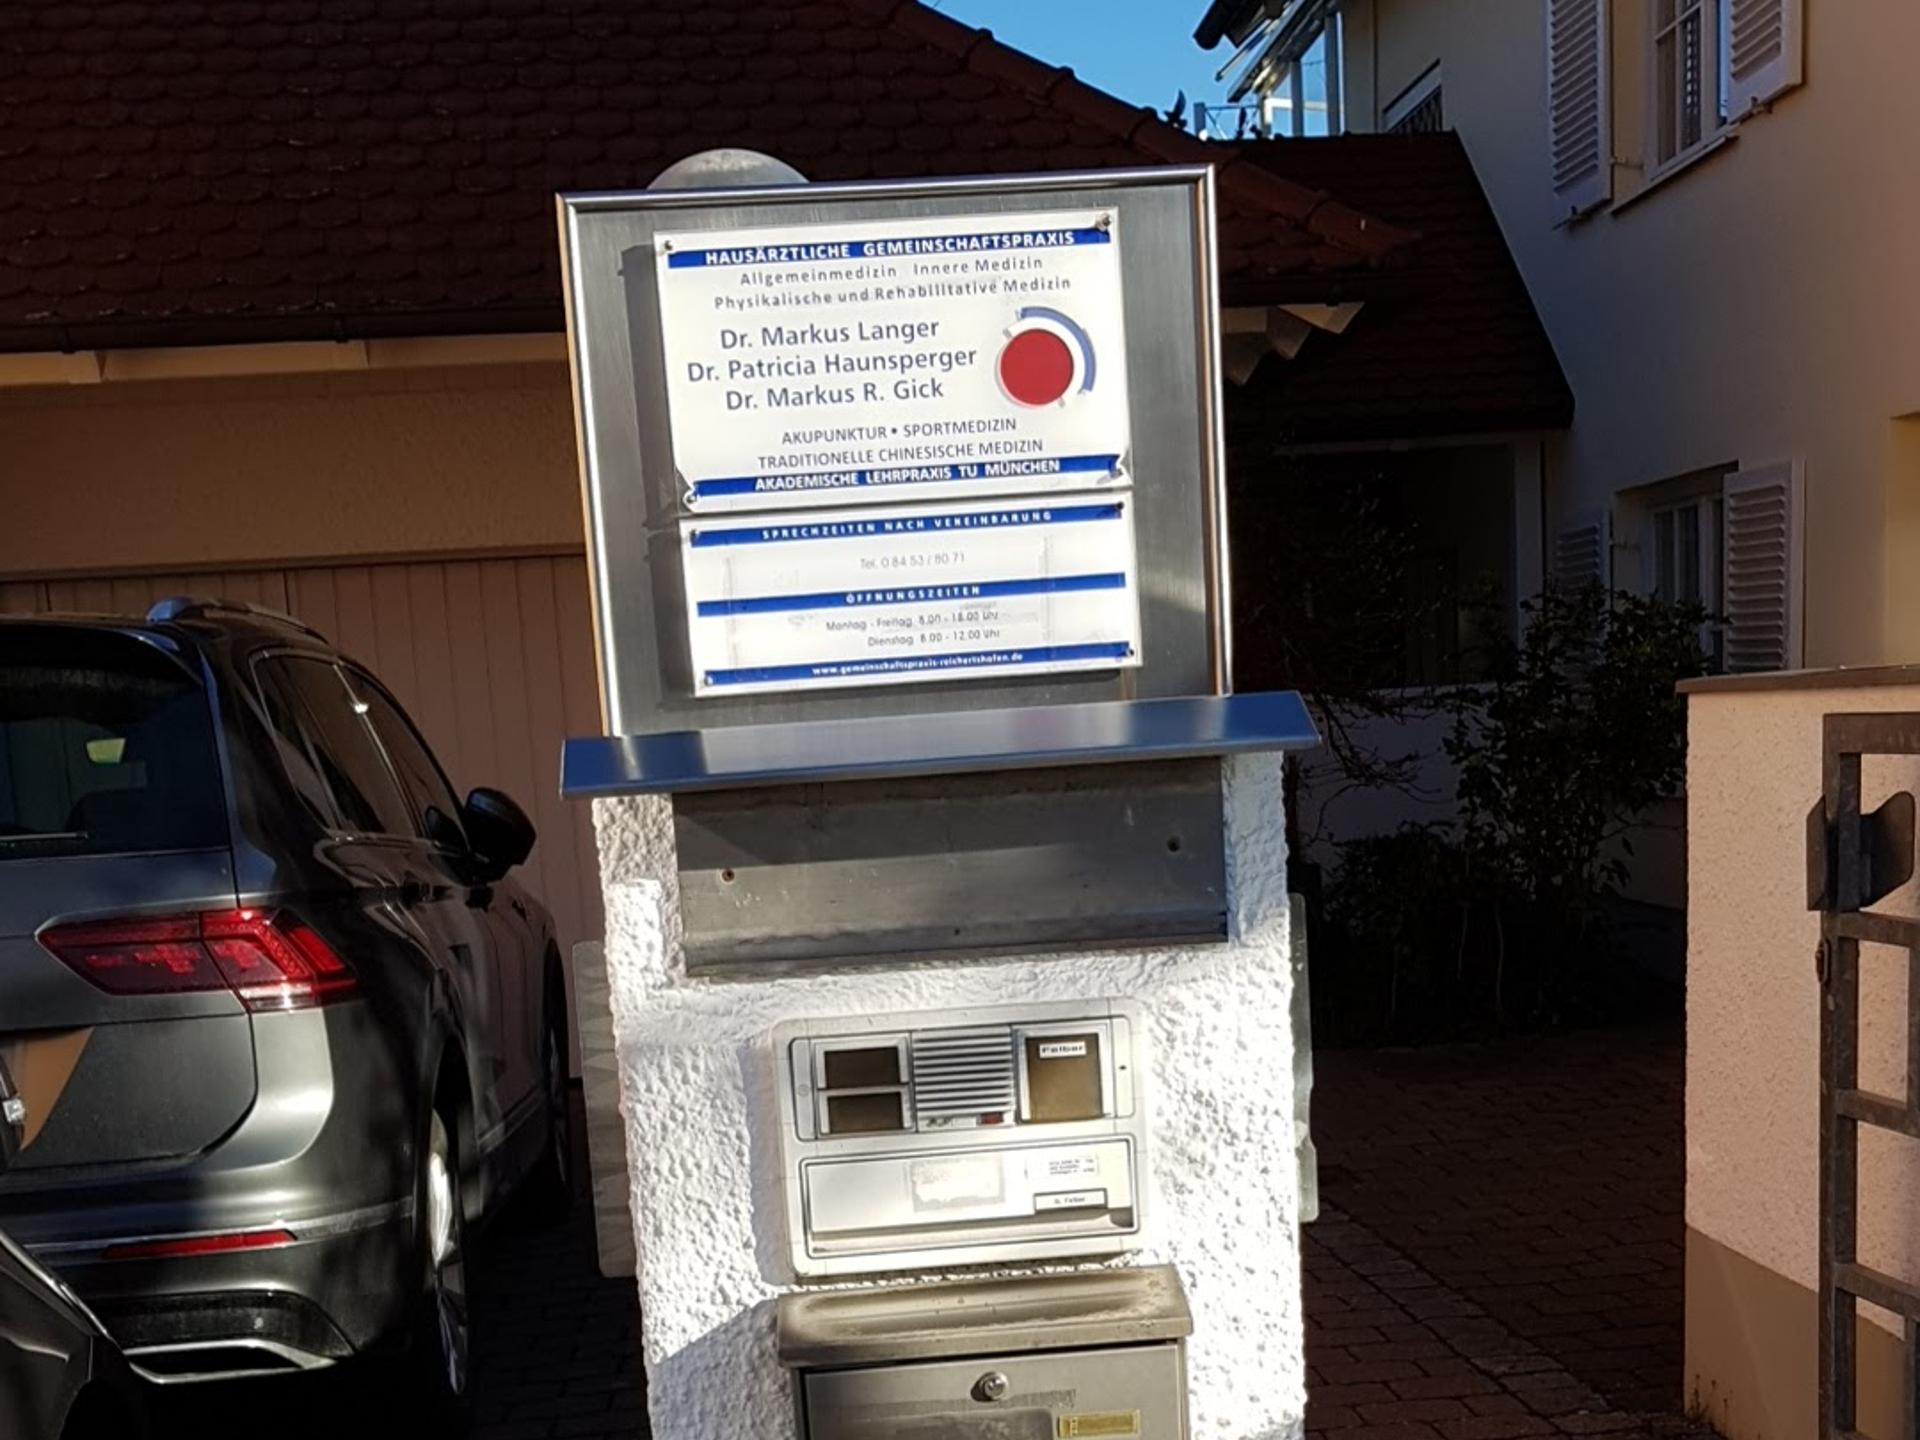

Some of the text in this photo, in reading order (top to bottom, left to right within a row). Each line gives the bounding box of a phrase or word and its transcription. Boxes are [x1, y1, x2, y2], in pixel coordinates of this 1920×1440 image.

[705, 231, 1075, 265] HAUSÄRZTLICHE GEMEINSCHAFTSPRAXIS
[740, 256, 1043, 287] Allgemeinmedizin Innere Medizin
[714, 277, 1071, 311] Physikalische und Rehabilitative Medizin
[720, 320, 940, 349] Dr. Markus Langer
[687, 349, 977, 382] Dr. Patricia Haunsperger
[726, 378, 944, 410] Dr. Markus R. Gick
[782, 418, 1017, 445] AKUPUNKTUR SPORTMEDIZIN
[757, 439, 1043, 470] TRADITIONELLE CHINESISCHE MEDIZIN
[754, 458, 1060, 491] AKADEMISCHE LEHRPRAXIS TU MÜNCHEN
[761, 511, 1052, 540] SPRECHZEITEN NACH VEREINBARUNG
